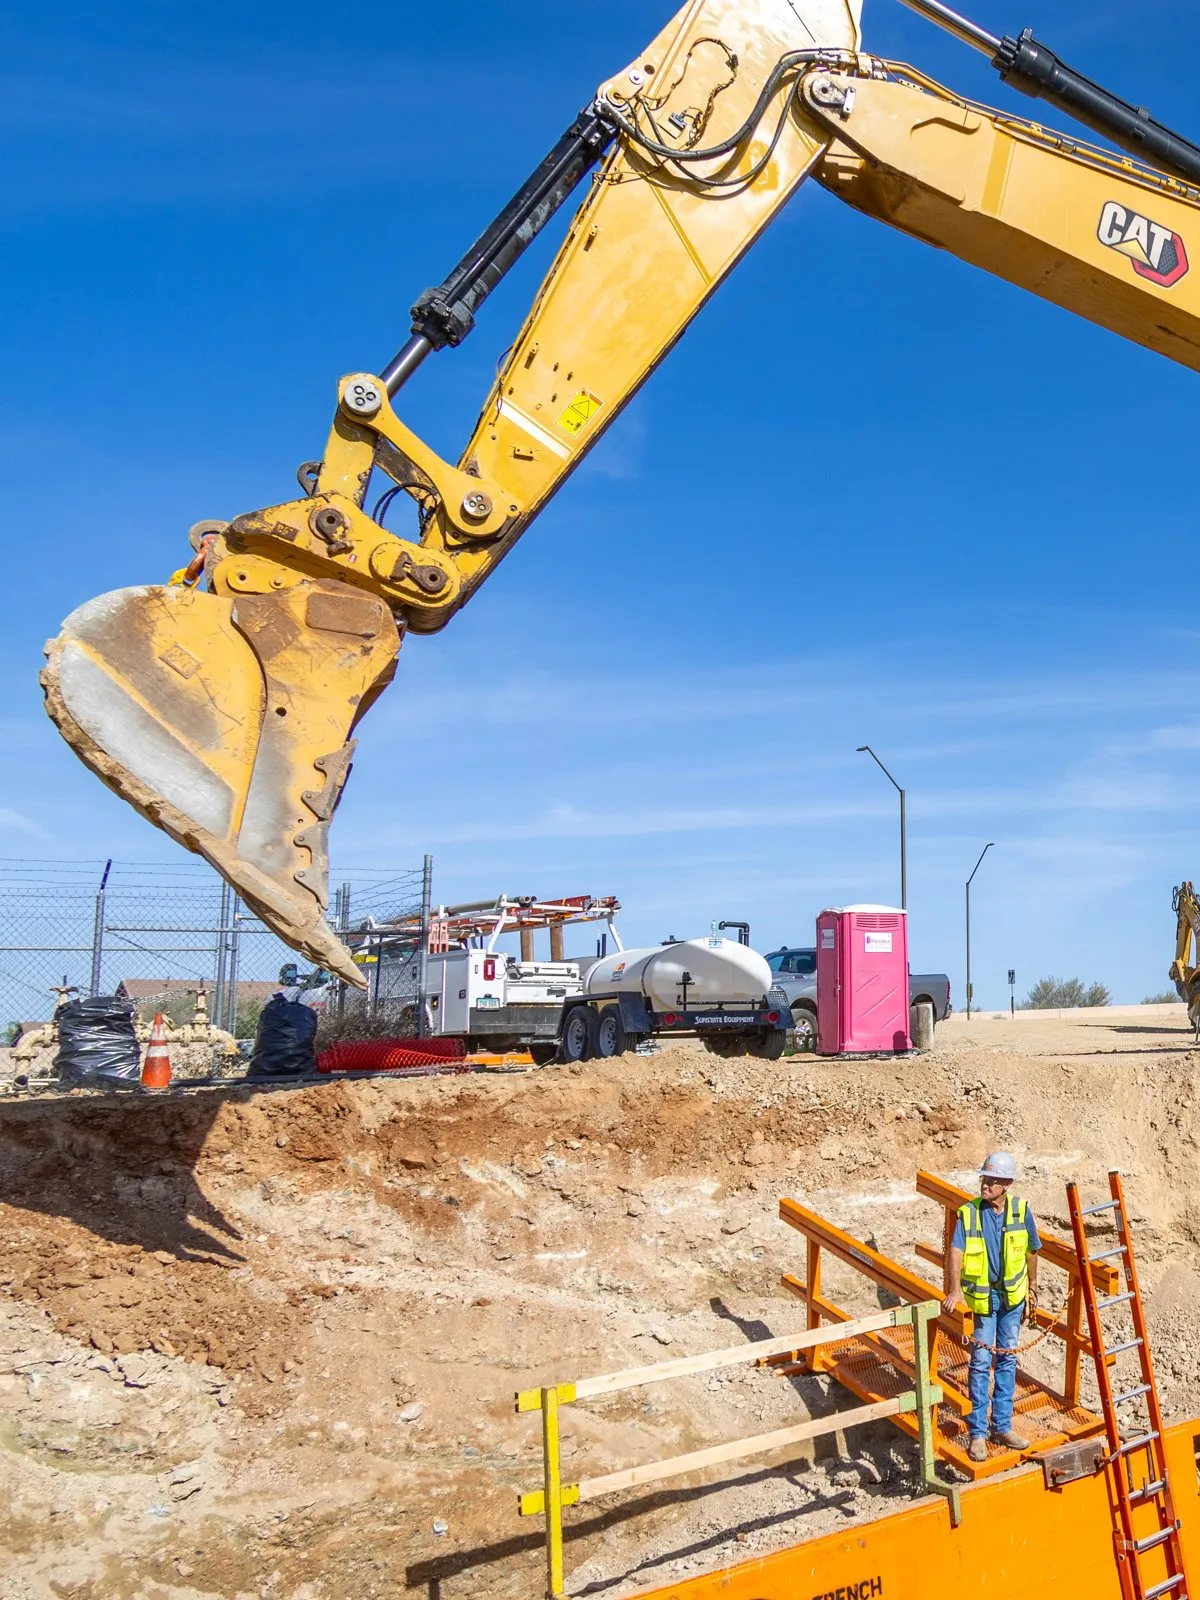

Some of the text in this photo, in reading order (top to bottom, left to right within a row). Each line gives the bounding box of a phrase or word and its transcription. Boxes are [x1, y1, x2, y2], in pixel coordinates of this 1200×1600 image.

[1099, 203, 1172, 269] CAT
[694, 1015, 755, 1025] SUNSTATE EQUIPMENT
[812, 1576, 882, 1600] ENCH
